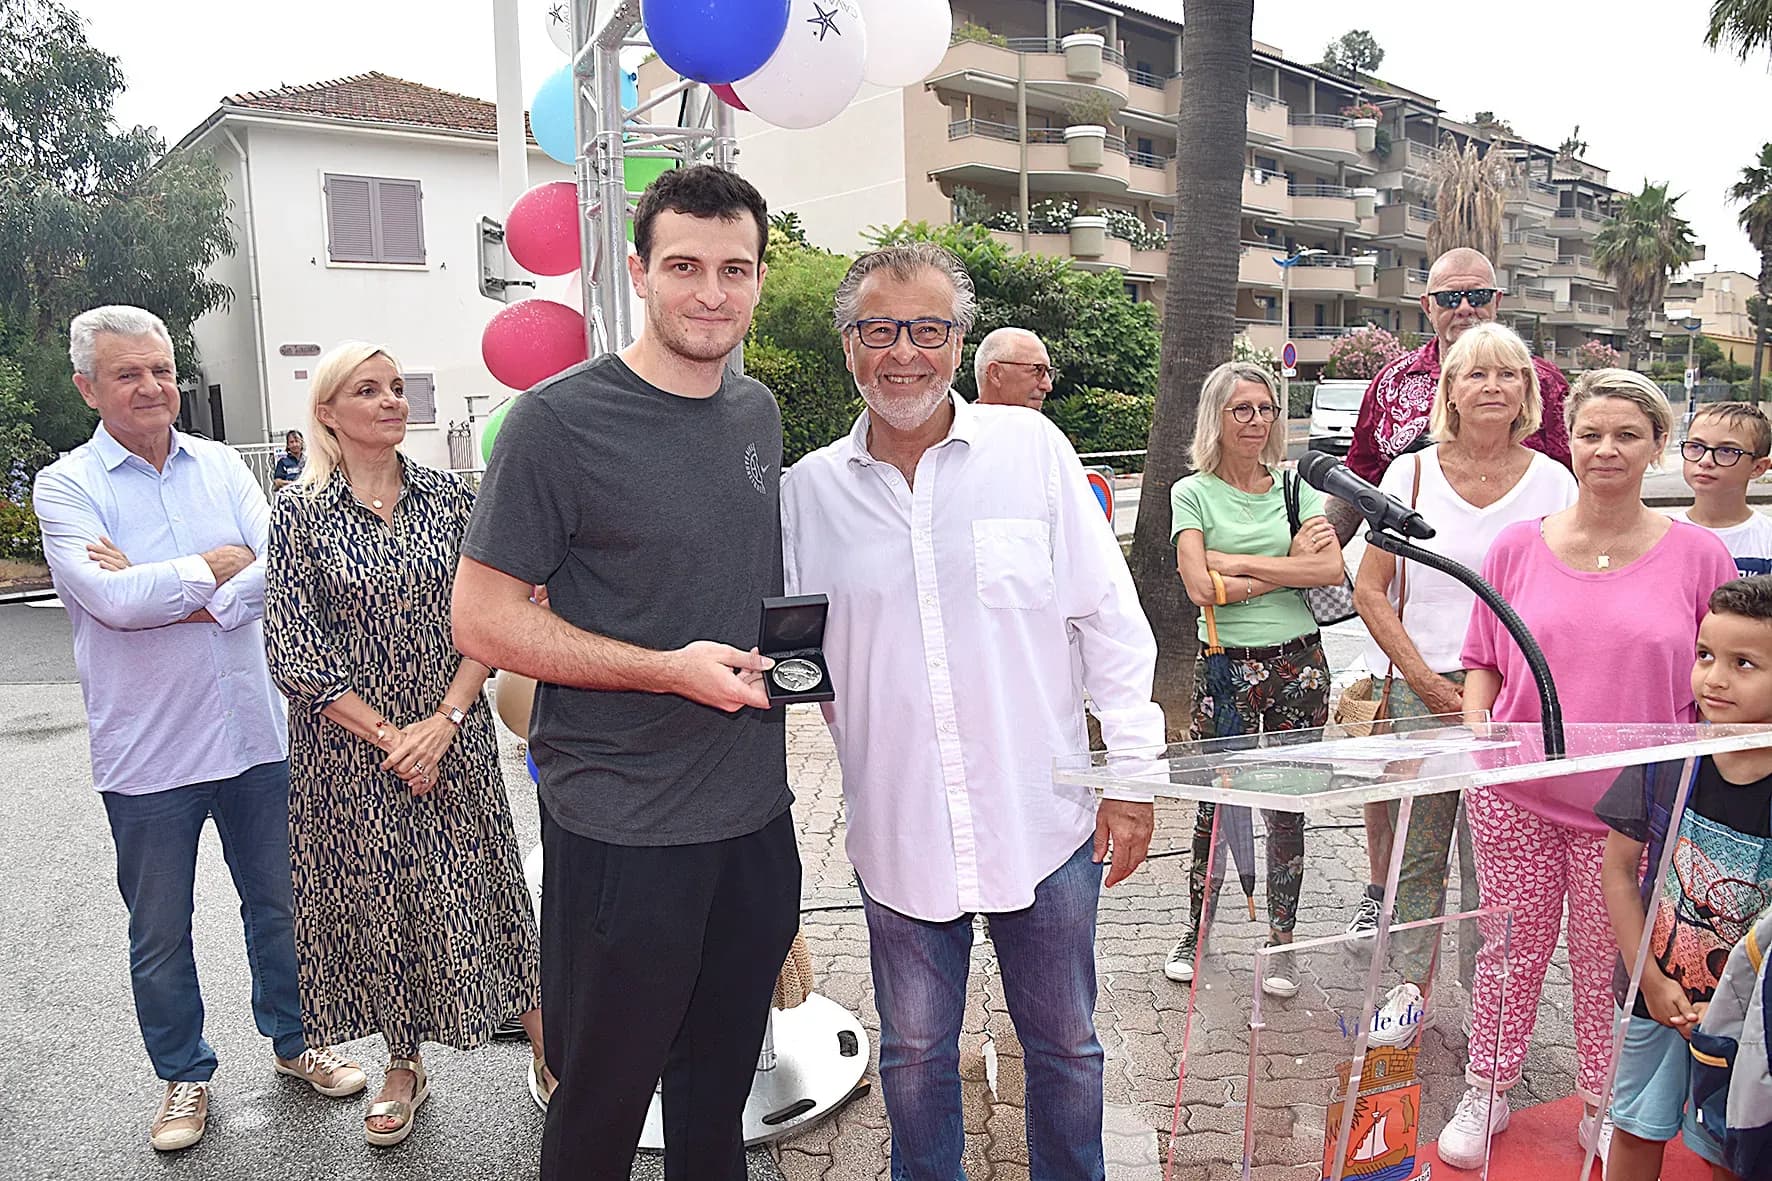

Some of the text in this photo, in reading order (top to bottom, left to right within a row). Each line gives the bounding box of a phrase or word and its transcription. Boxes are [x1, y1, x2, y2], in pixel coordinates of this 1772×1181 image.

[1724, 853, 1757, 873] PLAYER
[1337, 1004, 1424, 1038] Vile de
